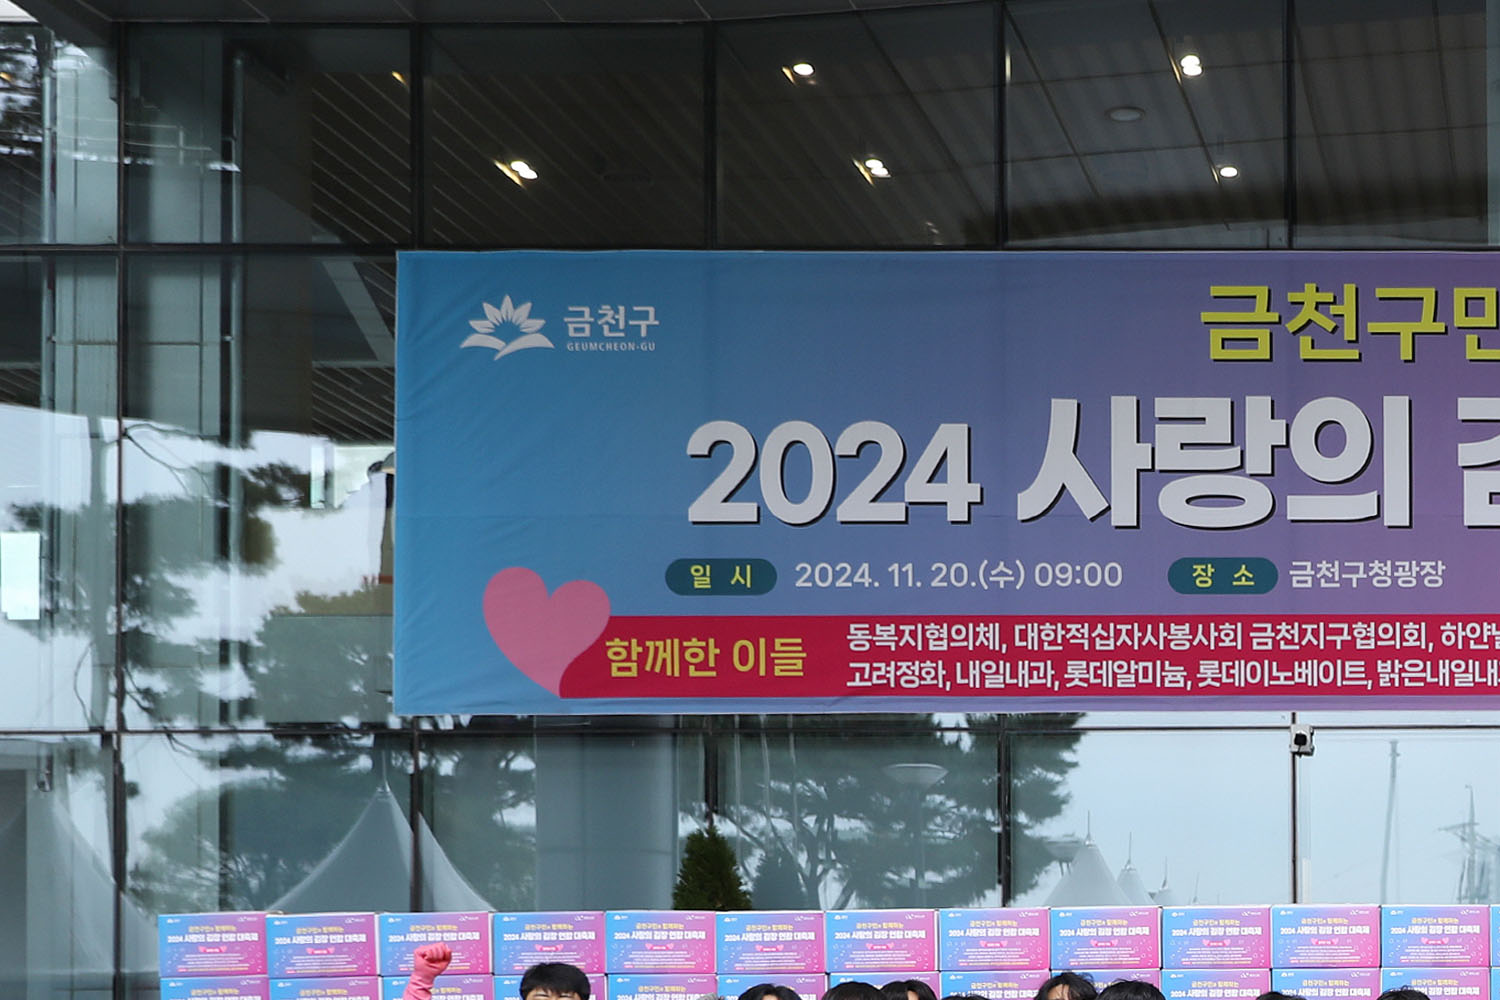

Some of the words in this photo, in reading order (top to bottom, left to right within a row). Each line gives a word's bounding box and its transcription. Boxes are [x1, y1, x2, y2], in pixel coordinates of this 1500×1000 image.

[564, 305, 659, 337] 금천구
[567, 342, 655, 351] GEUMCHEON-GU
[686, 420, 980, 525] 2024
[1018, 396, 1410, 528] 사랑의
[795, 562, 880, 588] 2024.
[888, 562, 921, 588] 11.
[930, 559, 1025, 590] 20.(수)
[1034, 561, 1123, 588] 09:00
[1289, 559, 1447, 588] 금천구청광장
[847, 623, 1007, 654] 동복지협의체,
[1014, 622, 1242, 651] 대한적십자사봉사회
[1249, 621, 1434, 653] 금천지구협의회,
[606, 638, 721, 677] 함께한
[733, 638, 807, 677] 이들
[847, 660, 951, 691] 고려정화,
[956, 659, 1060, 691] 내일내과,
[1064, 659, 1192, 691] 롯데알미늄,
[1196, 659, 1373, 691] 롯데이노베이트,
